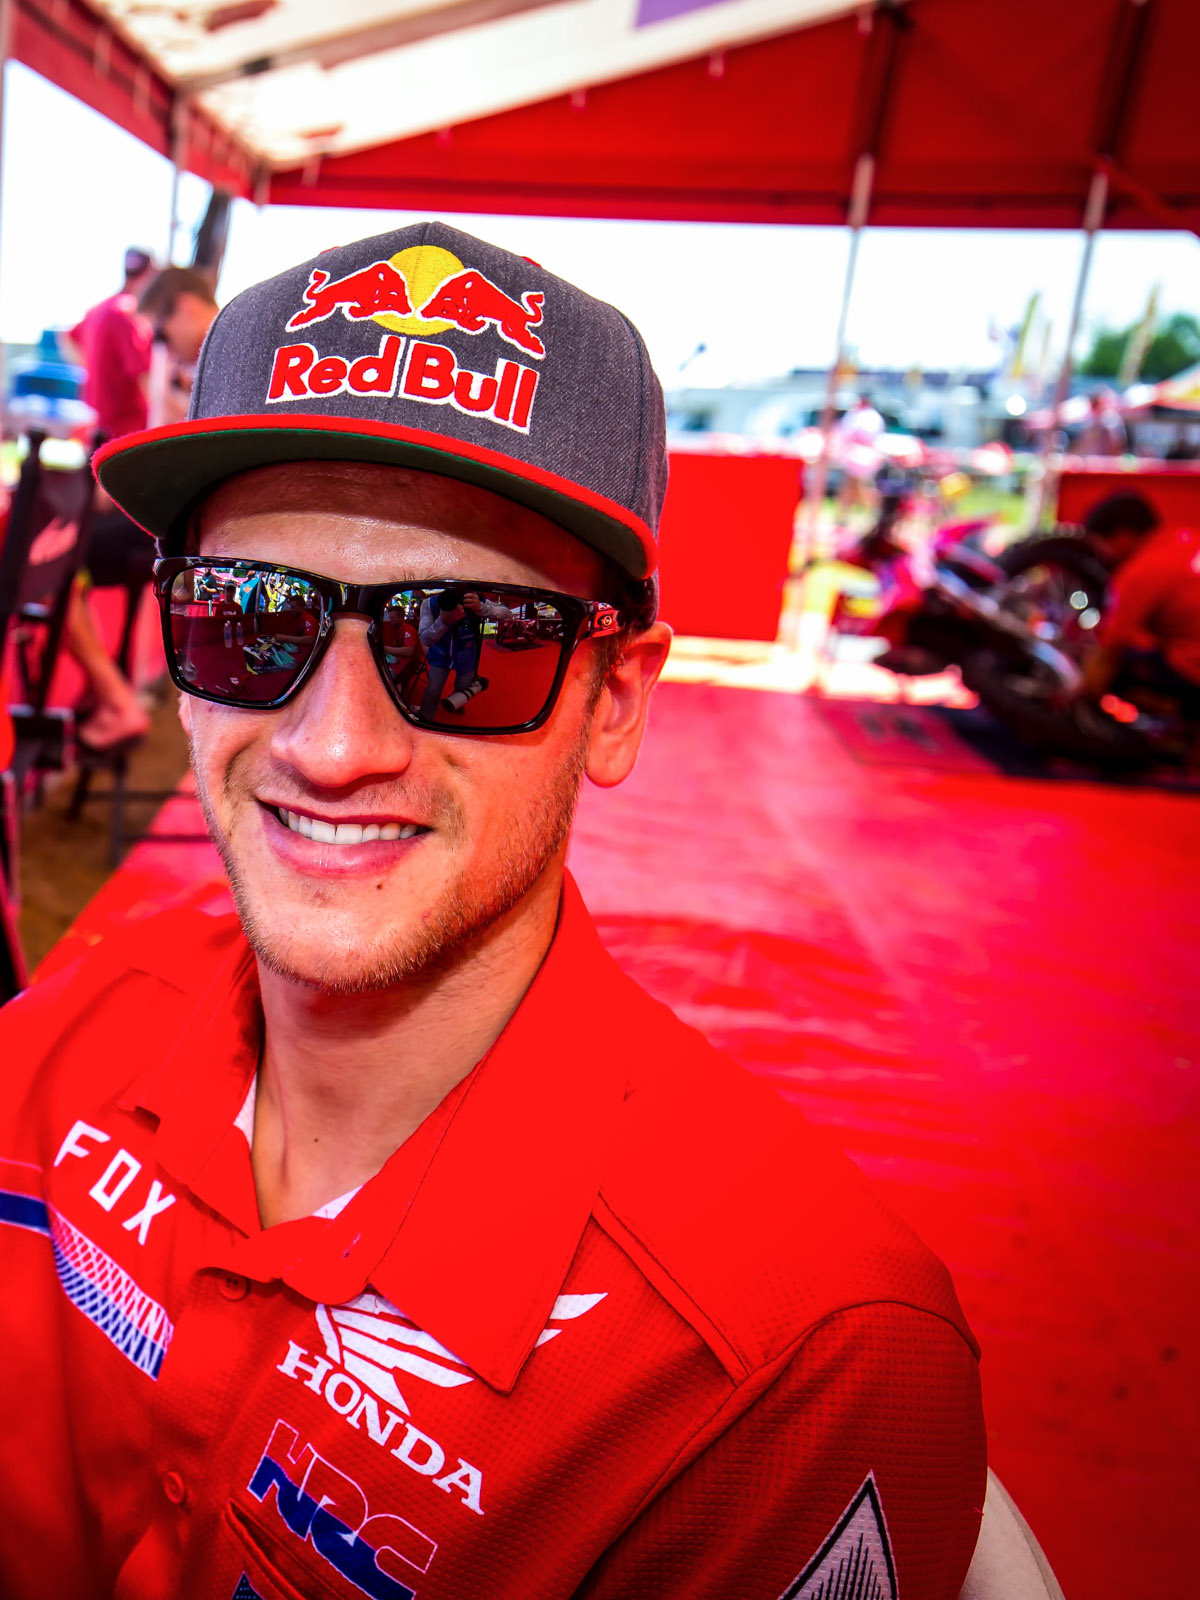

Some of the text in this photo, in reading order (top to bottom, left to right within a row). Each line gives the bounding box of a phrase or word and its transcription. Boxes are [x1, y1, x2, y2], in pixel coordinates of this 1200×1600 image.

[266, 334, 540, 435] Red Bull
[54, 1120, 176, 1246] FOX
[276, 1340, 485, 1515] HONDA
